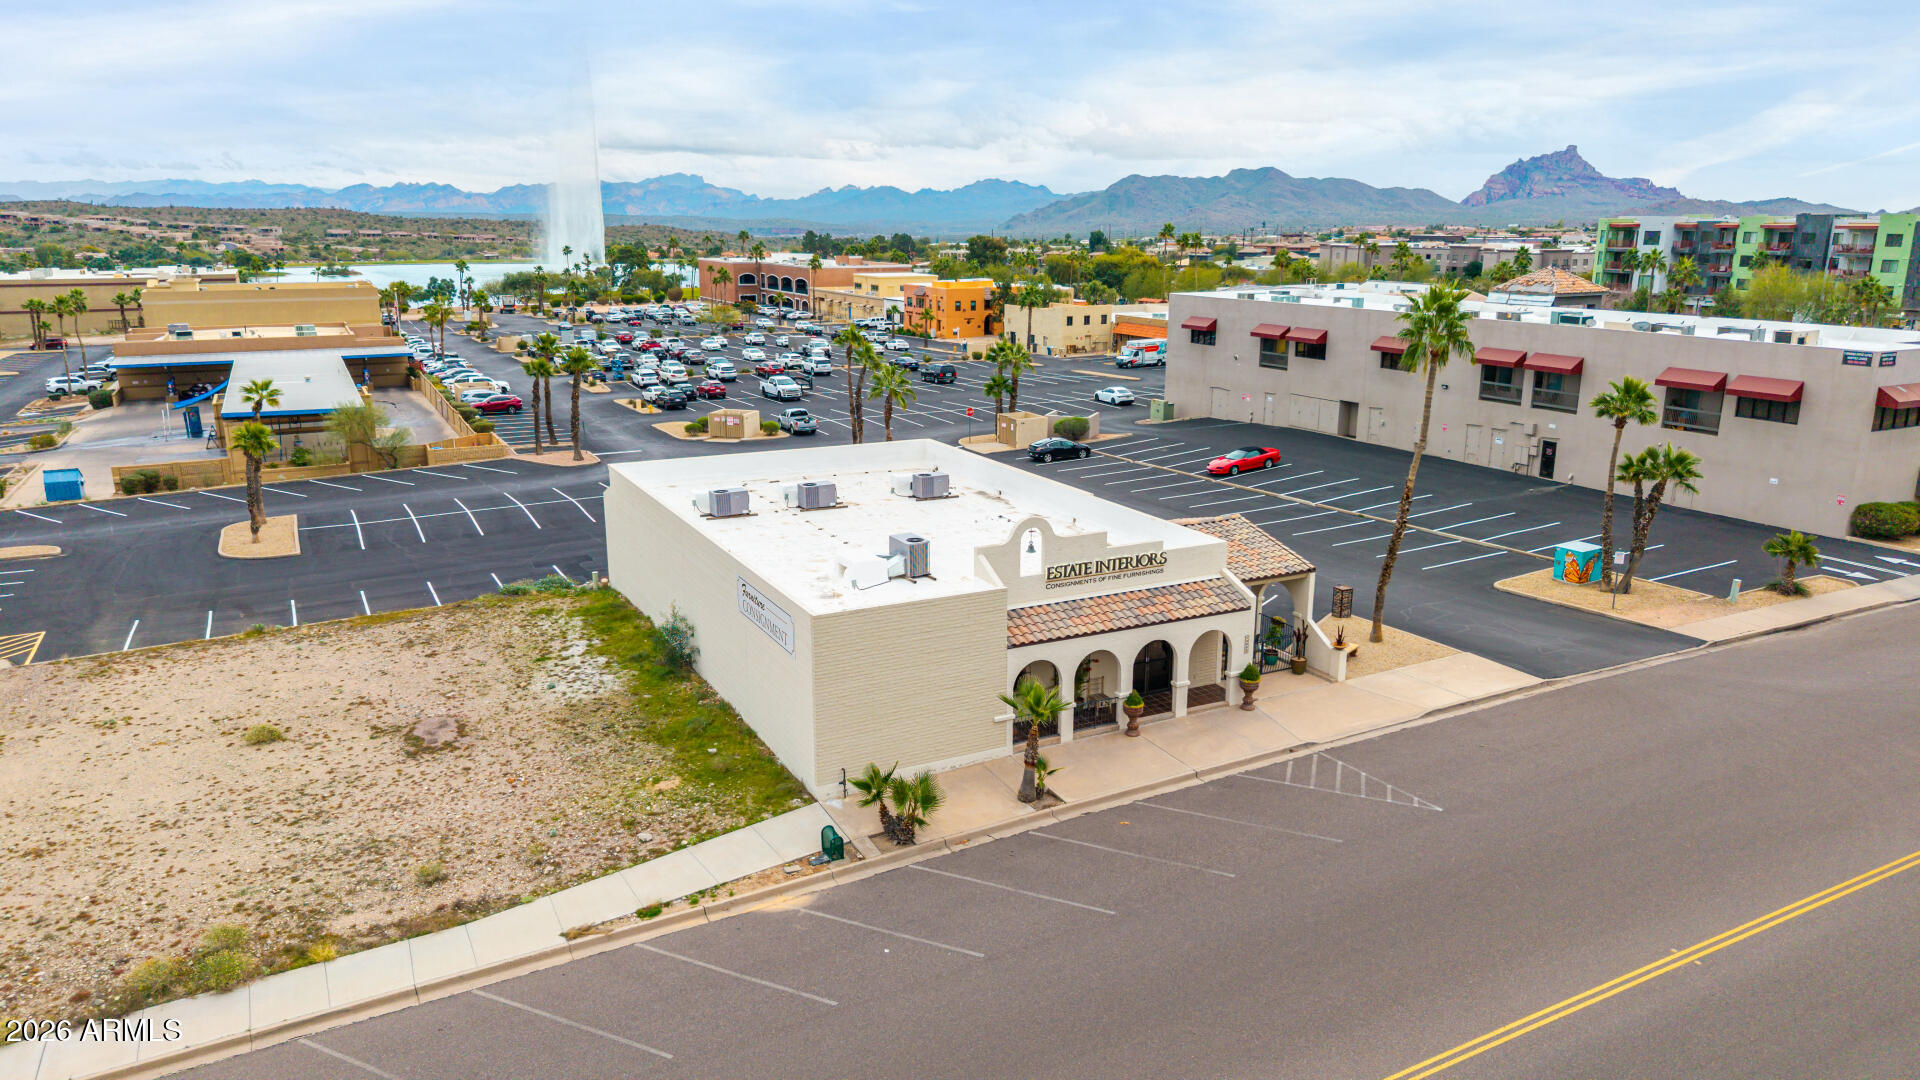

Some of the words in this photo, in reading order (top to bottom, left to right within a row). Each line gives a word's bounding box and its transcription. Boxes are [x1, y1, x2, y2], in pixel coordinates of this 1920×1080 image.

[1046, 561, 1093, 580] ESTATE
[1095, 551, 1168, 574] INTERIORS
[1045, 577, 1098, 590] CONSIGNMENTS
[1098, 575, 1107, 583] OF
[1107, 571, 1122, 581] FINE
[1122, 568, 1165, 580] FURNISHINGS
